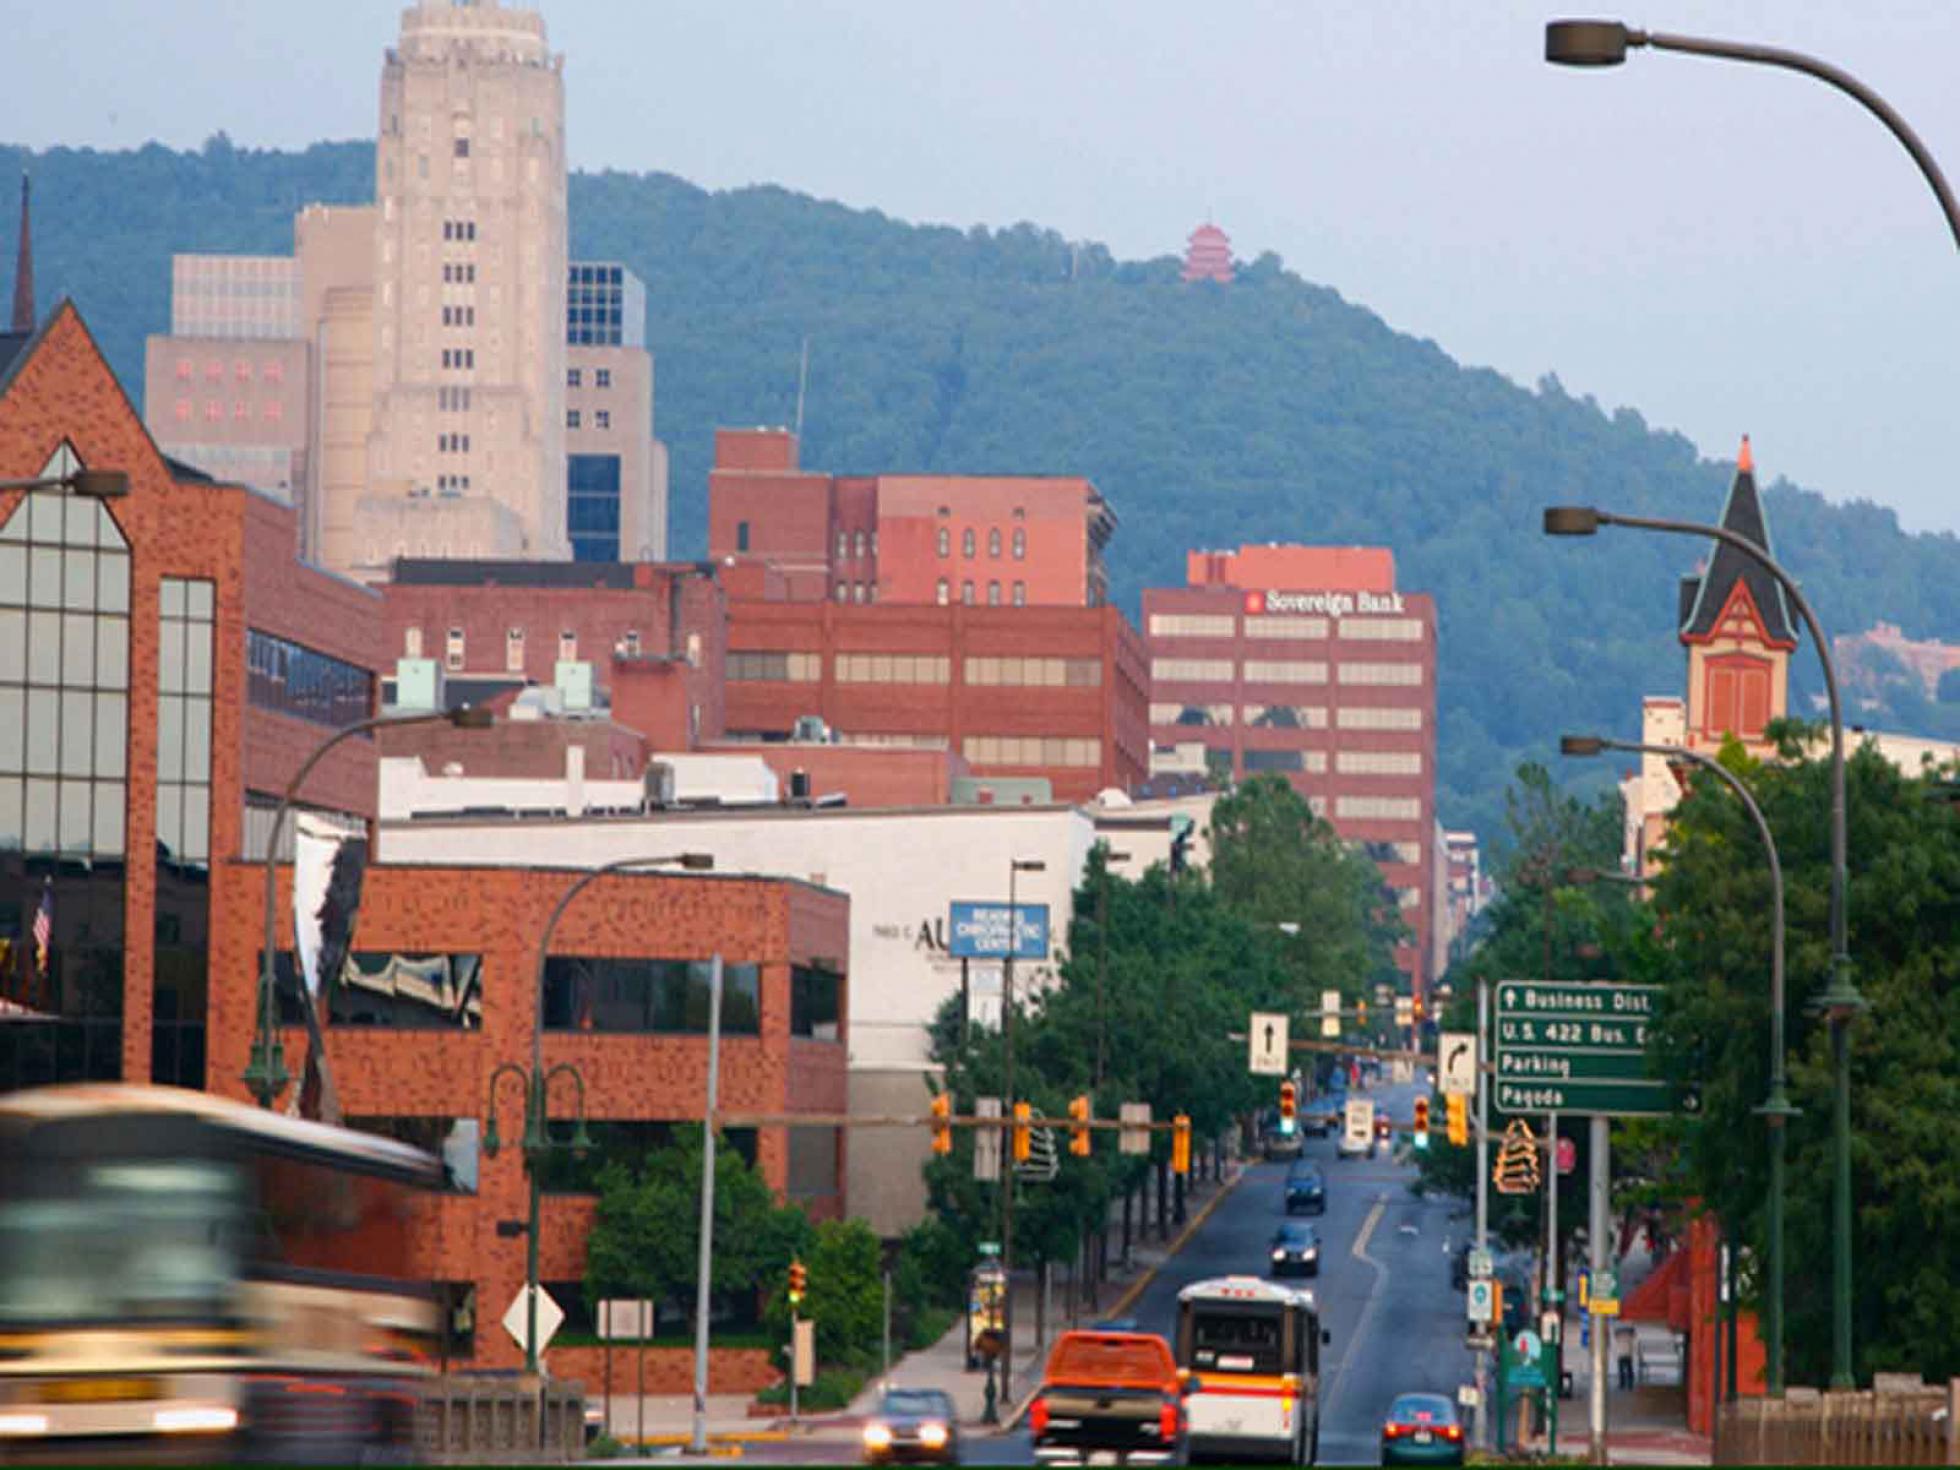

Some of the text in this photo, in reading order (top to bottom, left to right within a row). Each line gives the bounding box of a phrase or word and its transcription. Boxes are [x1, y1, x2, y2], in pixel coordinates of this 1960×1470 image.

[1266, 589, 1405, 617] Sovereign Bank
[1525, 988, 1602, 1010] Business
[1545, 1023, 1582, 1043] 422
[1502, 1054, 1570, 1079] Parking
[1502, 1085, 1563, 1109] Pagoda
